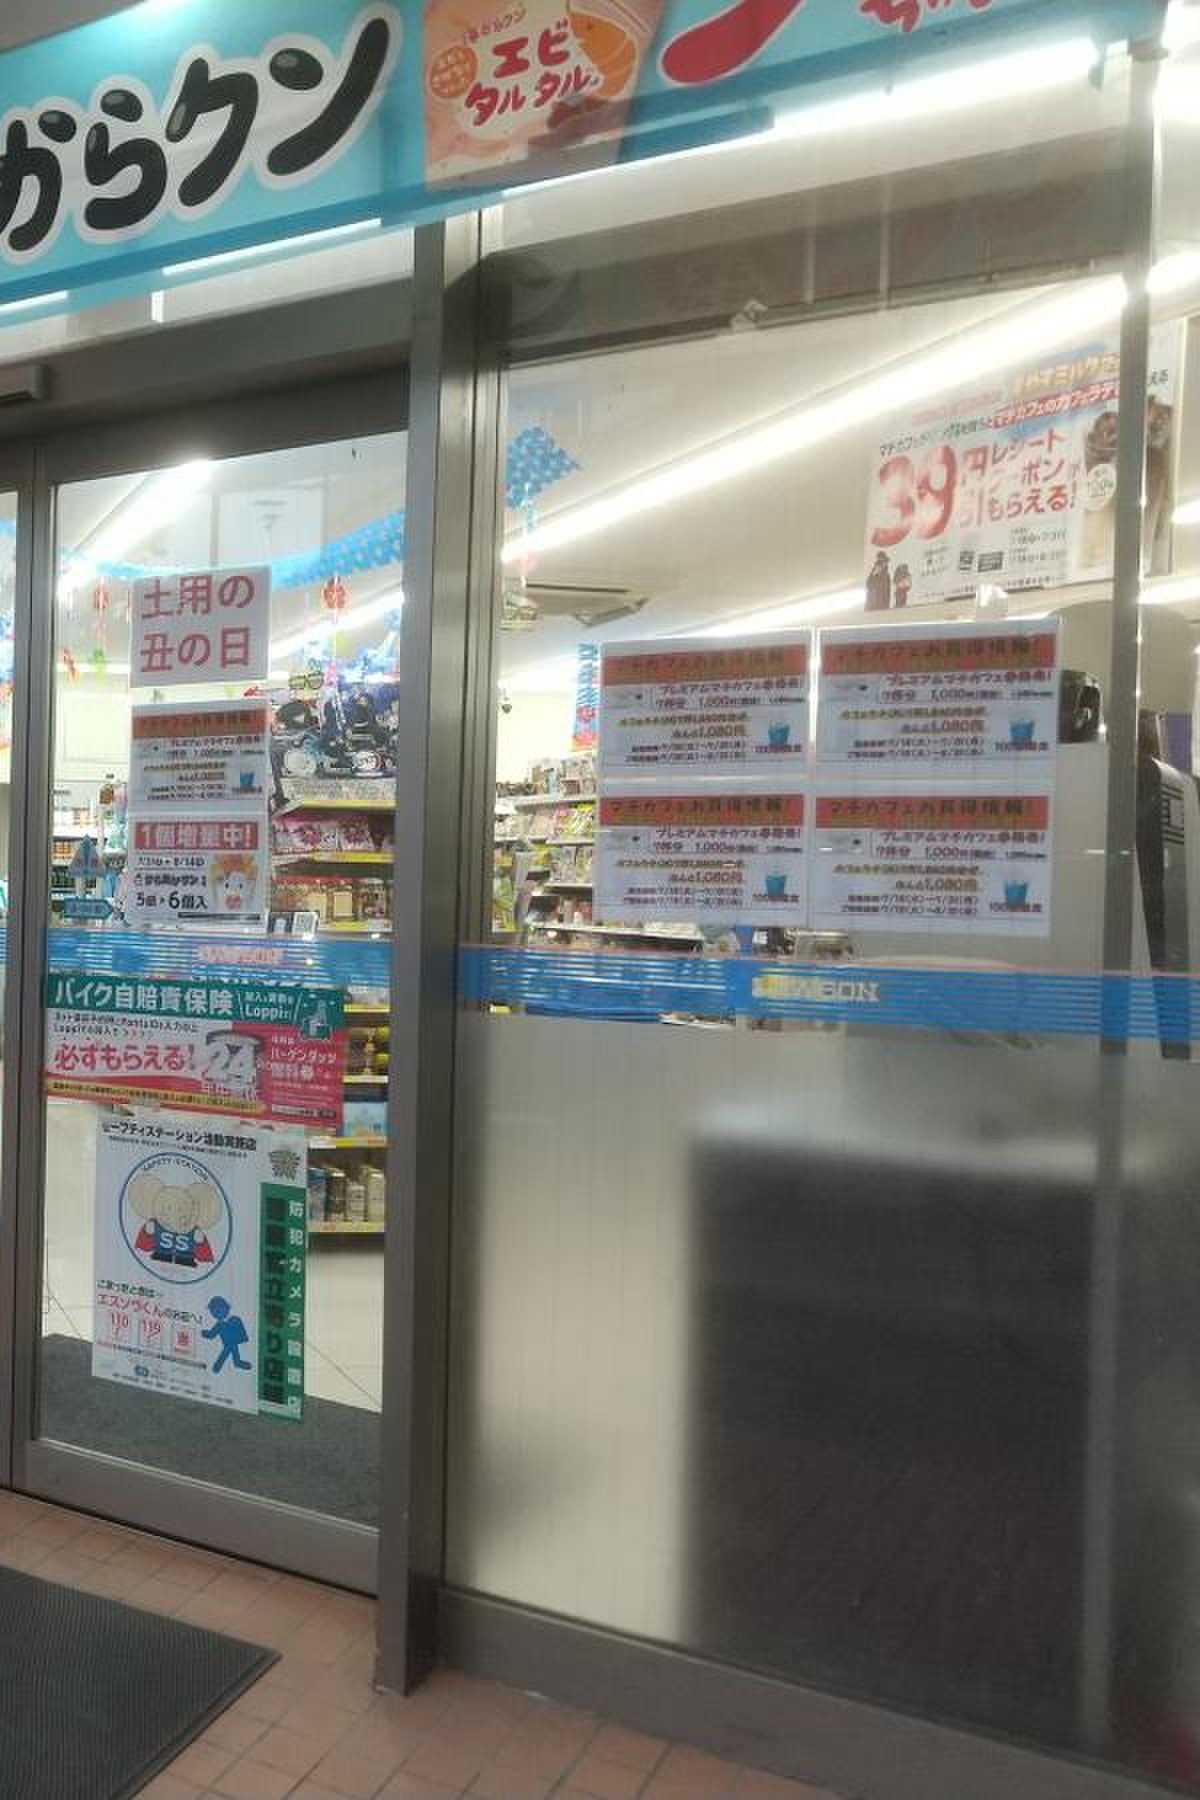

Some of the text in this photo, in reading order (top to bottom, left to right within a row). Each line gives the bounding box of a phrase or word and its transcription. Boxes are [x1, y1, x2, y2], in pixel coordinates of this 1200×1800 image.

[491, 19, 571, 79] エビ
[464, 64, 590, 127] タルタル
[871, 444, 957, 546] 39
[141, 575, 255, 621] 土用の
[141, 627, 250, 673] 丑の日
[54, 980, 234, 1016] バイク自賠責保険
[159, 1233, 190, 1250] SS
